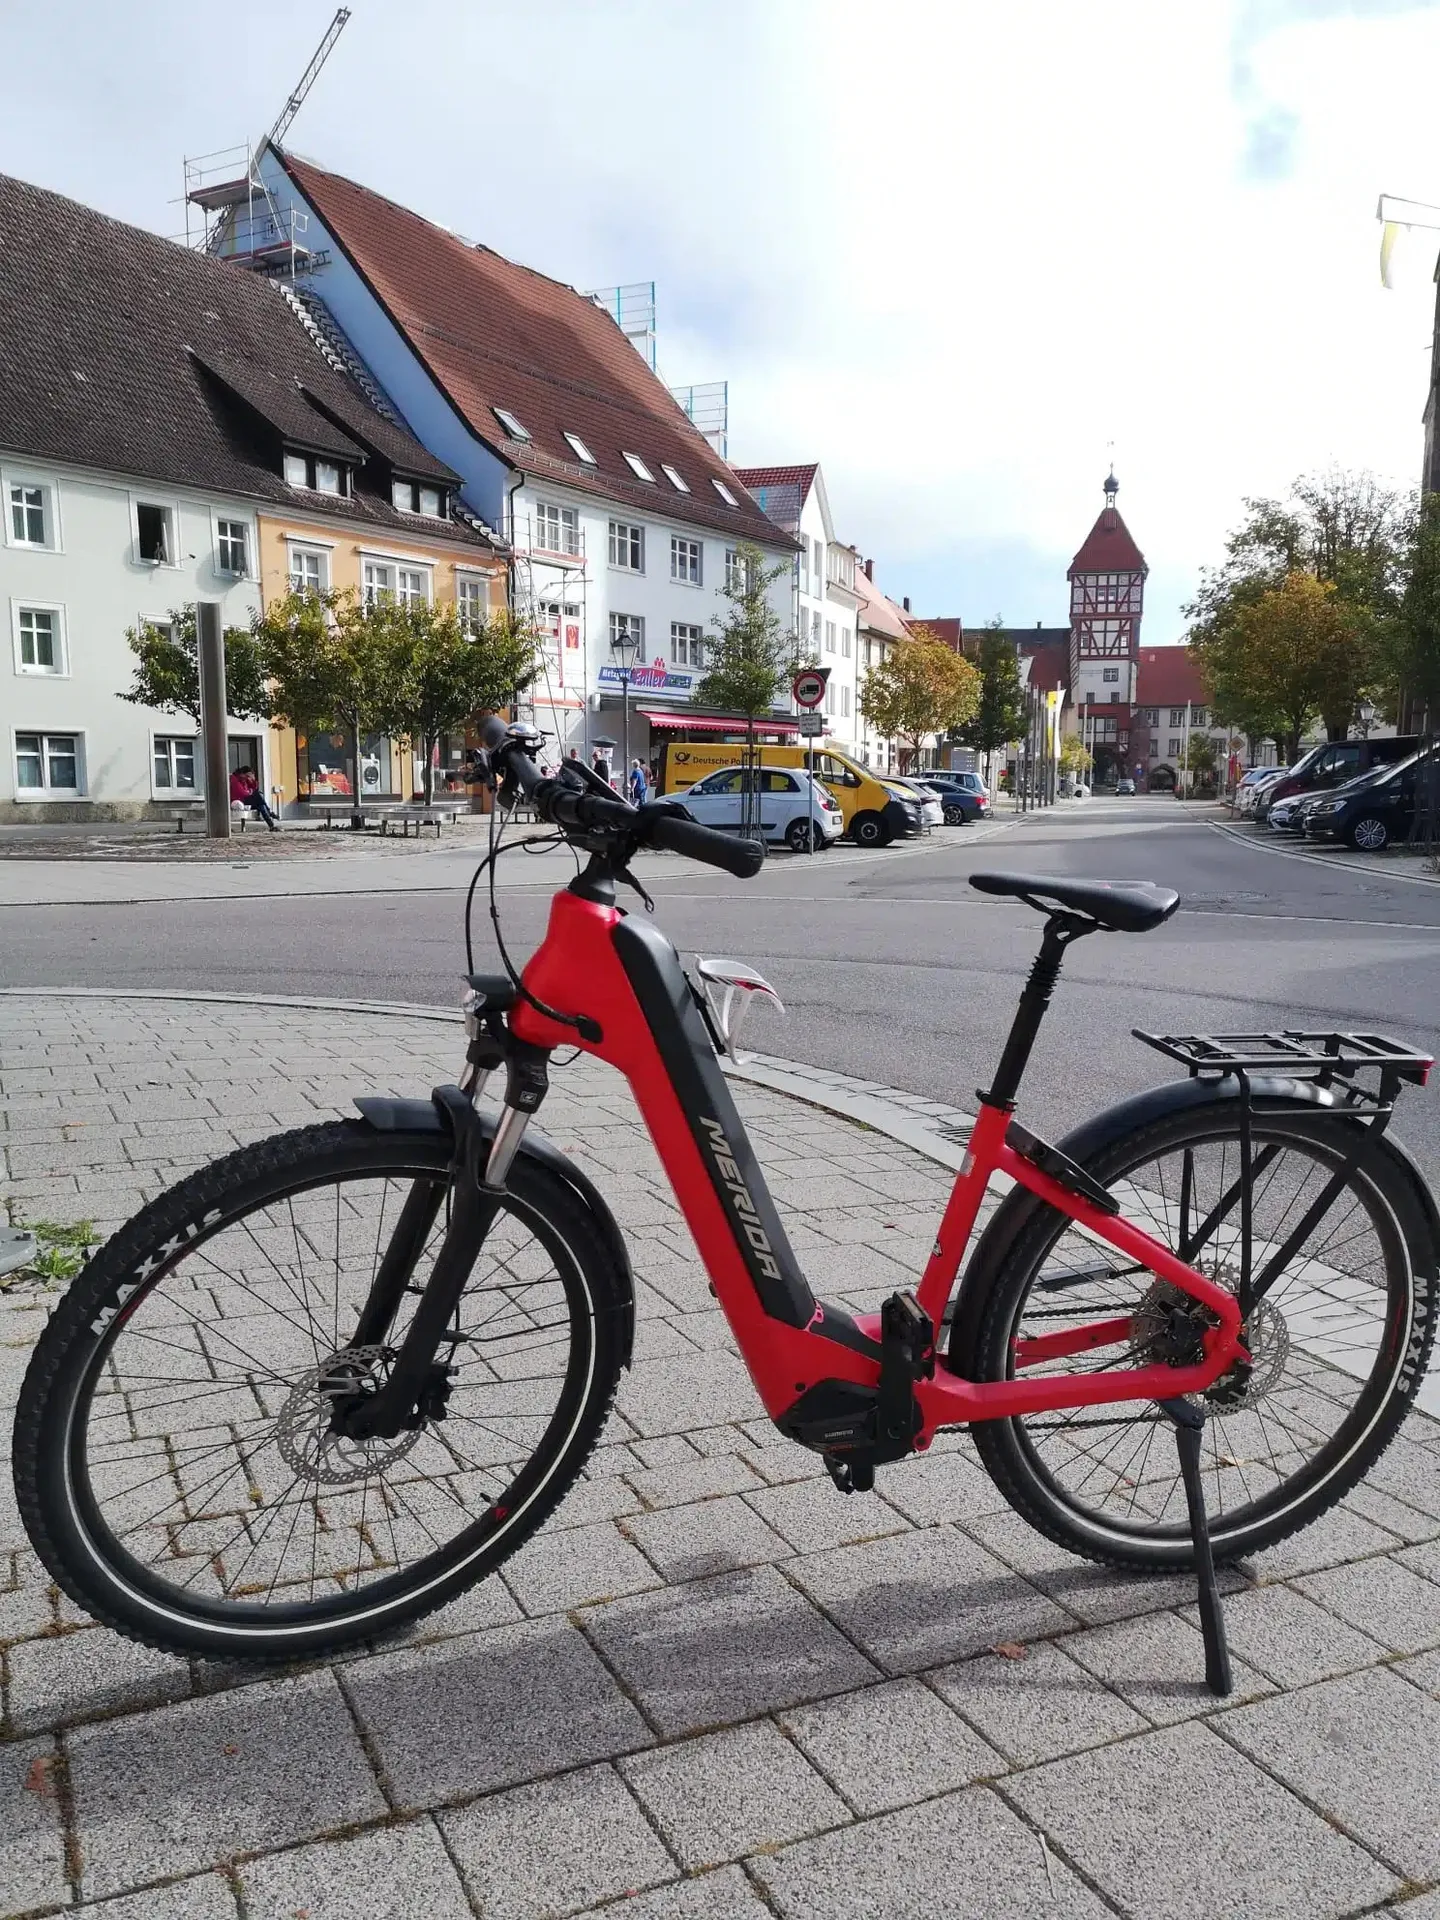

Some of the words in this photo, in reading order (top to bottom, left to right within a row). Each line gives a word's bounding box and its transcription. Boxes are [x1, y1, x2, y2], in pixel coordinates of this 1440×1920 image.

[693, 756, 729, 765] Deutsche
[698, 1115, 783, 1281] MERIDA
[90, 1208, 223, 1336] MAXXIS
[1396, 1275, 1429, 1394] MAXXIS
